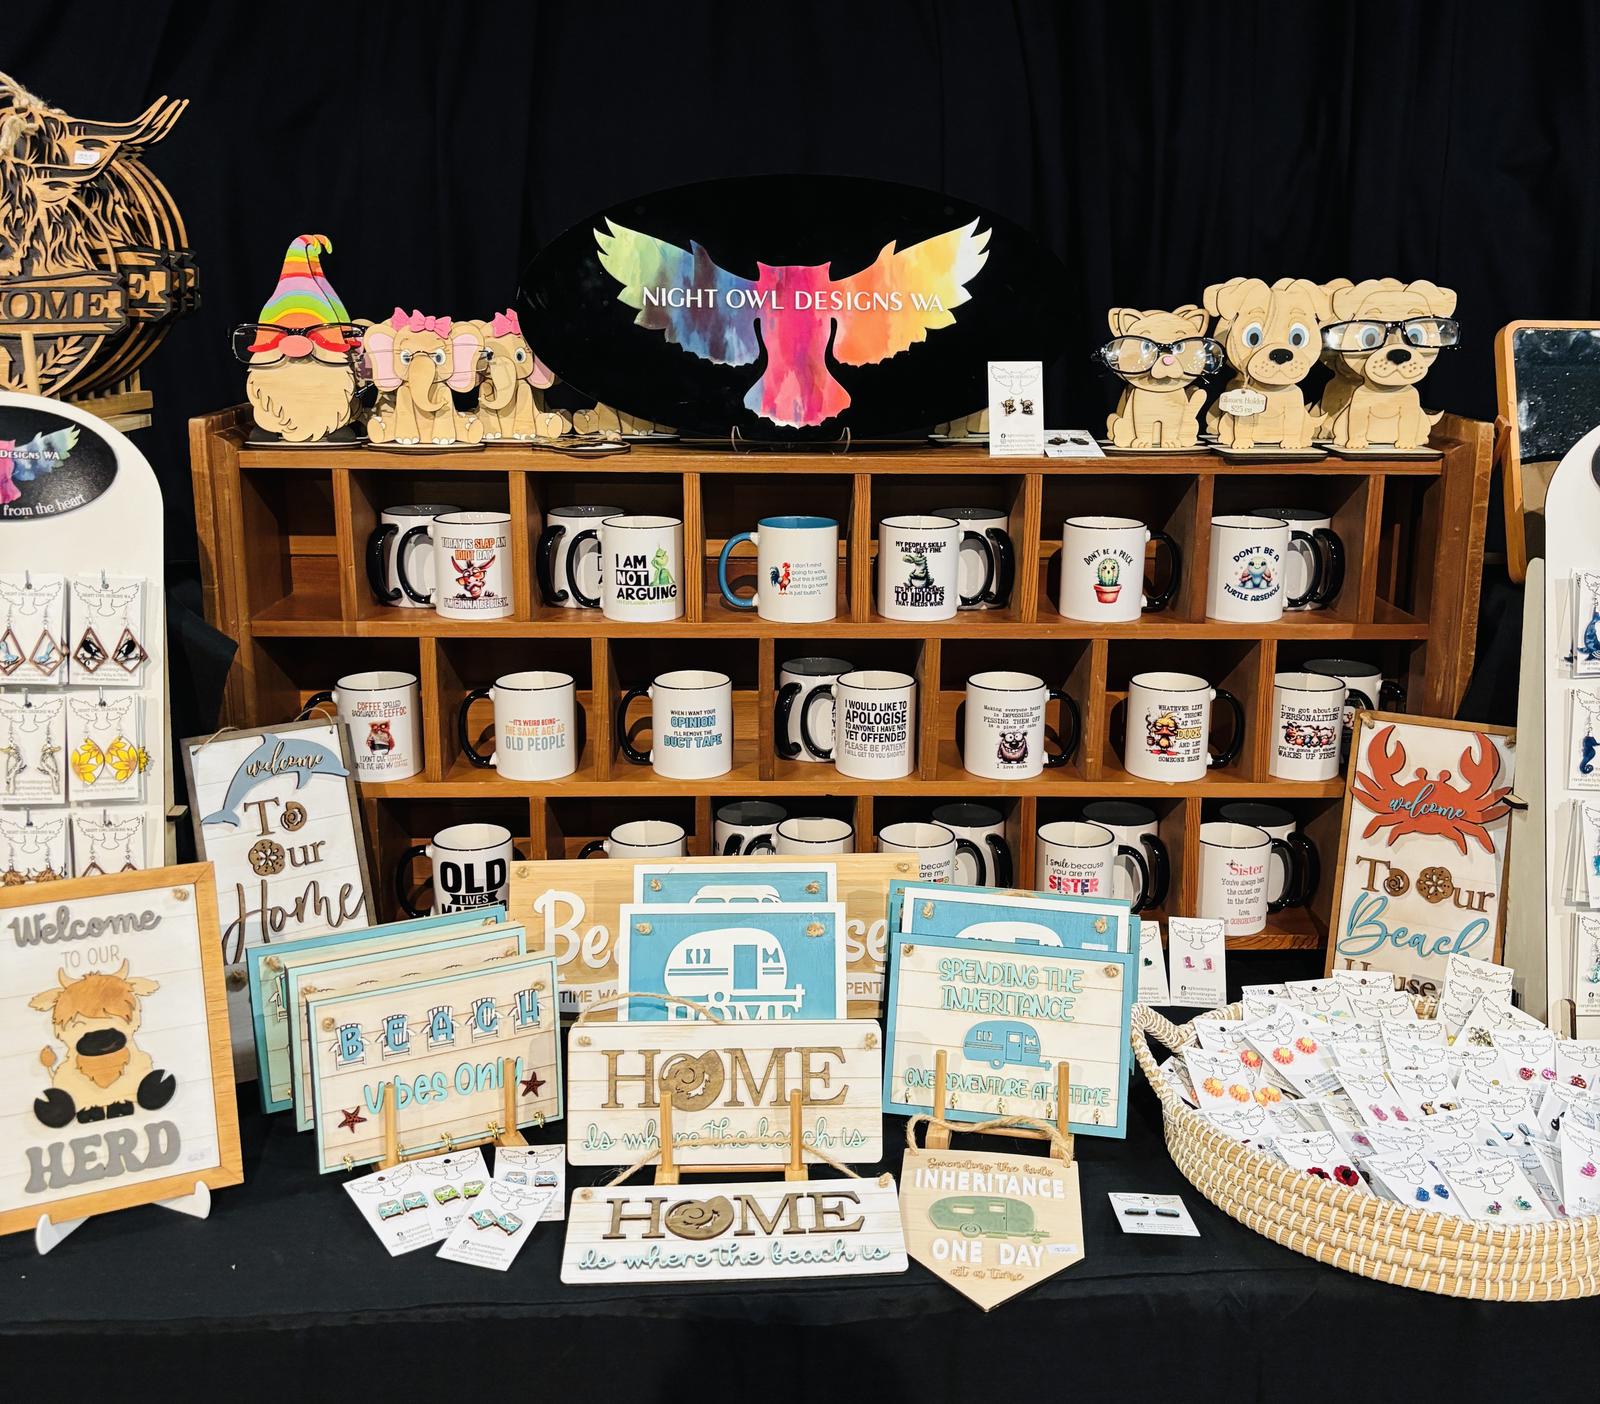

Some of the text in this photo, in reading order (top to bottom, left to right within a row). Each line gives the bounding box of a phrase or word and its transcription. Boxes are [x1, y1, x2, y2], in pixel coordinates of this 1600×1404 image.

[642, 286, 945, 312] NIGHT OWL DESIGNS WA
[43, 451, 60, 460] WA
[3, 493, 87, 517] from the heart
[441, 536, 507, 549] TODAY IS SLAP AN
[455, 549, 494, 561] IDIOT DAY
[615, 553, 647, 569] I AM
[1083, 549, 1101, 565] DON'T
[1118, 549, 1134, 566] PRICK
[1232, 546, 1275, 562] DON'T BE
[616, 570, 648, 586] NOT
[616, 584, 677, 601] ARGUING
[895, 592, 945, 602] TO IDIOTS
[1223, 583, 1281, 602] TURTLE ARSEHOLE
[454, 599, 478, 609] GONNA
[356, 700, 401, 711] COFFEE SPELLED
[383, 706, 407, 718] EEFFOC
[848, 699, 907, 711] WOULD LIKE TO
[1158, 704, 1189, 712] WHATEVER
[1281, 704, 1295, 712] I've
[541, 718, 556, 726] BEING
[670, 715, 716, 728] OPINION
[845, 709, 907, 725] APOLOGISE
[983, 716, 1009, 725] PISSING
[505, 723, 566, 737] THE SAME AGE AS
[845, 721, 907, 732] TO ANYONE HAVE NOT
[505, 734, 566, 751] OLD PEOPLE
[663, 733, 723, 748] DUCT TAPE
[845, 729, 907, 743] YET OFFENDED
[845, 740, 906, 752] PLEASE BE PATIENT
[246, 741, 324, 776] welcome
[1278, 750, 1302, 759] WAKES
[1318, 751, 1336, 760] FIRST
[1388, 783, 1466, 820] welcome
[919, 860, 950, 871] because
[1046, 854, 1104, 869] I smile because
[440, 857, 507, 894] OLD
[1052, 867, 1067, 876] you
[1084, 870, 1096, 878] my
[1229, 864, 1264, 876] Sister
[1048, 875, 1099, 894] SISTER
[459, 894, 489, 905] LIVES
[7, 905, 162, 948] Welcome
[221, 879, 366, 966] Home
[61, 944, 120, 968] TO OUR
[938, 957, 1084, 994] SPENDING THE
[559, 989, 593, 1004] TIME
[943, 985, 1076, 1021] INHERITANCE
[339, 989, 541, 1062] BEACH
[601, 1047, 850, 1112] HOME
[904, 1068, 936, 1089] ONE
[1030, 1081, 1052, 1100] AT
[1068, 1084, 1111, 1107] TIME
[363, 1072, 448, 1114] Vbes
[704, 1117, 750, 1149] the
[842, 1127, 870, 1148] is
[25, 1119, 182, 1194] HERD
[927, 1157, 993, 1174] Spending
[994, 1161, 1020, 1173] the
[914, 1168, 1066, 1200] INHERITANCE
[602, 1191, 865, 1241] HOME
[624, 1244, 713, 1269] where
[712, 1242, 766, 1267] the
[770, 1238, 857, 1265] beach
[860, 1243, 891, 1262] is
[932, 1238, 1046, 1268] ONE DAY
[950, 1266, 1025, 1281] at a time
